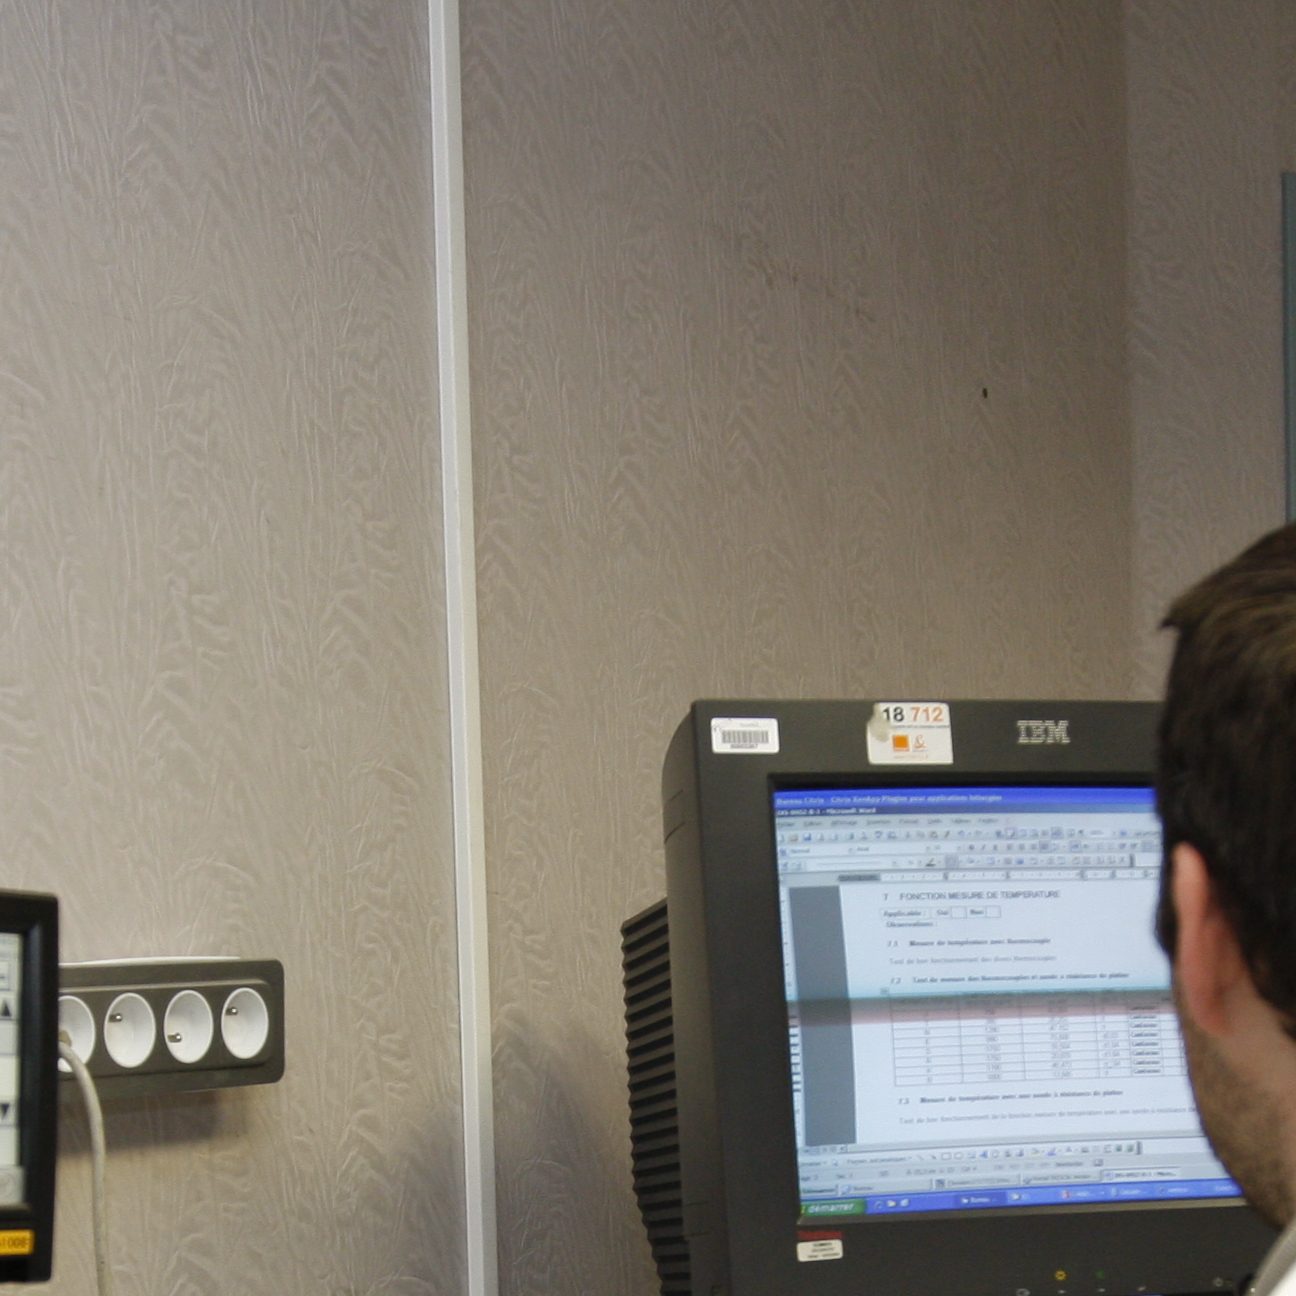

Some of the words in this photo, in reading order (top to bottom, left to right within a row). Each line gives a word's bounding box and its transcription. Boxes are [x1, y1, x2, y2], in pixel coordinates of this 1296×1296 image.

[882, 707, 905, 723] 18
[911, 707, 944, 722] 712
[1017, 720, 1070, 744] IBM
[899, 892, 946, 901] FONCTION
[948, 891, 984, 900] MESURE
[986, 891, 998, 899] DE
[1001, 889, 1061, 899] TEMPERATURE
